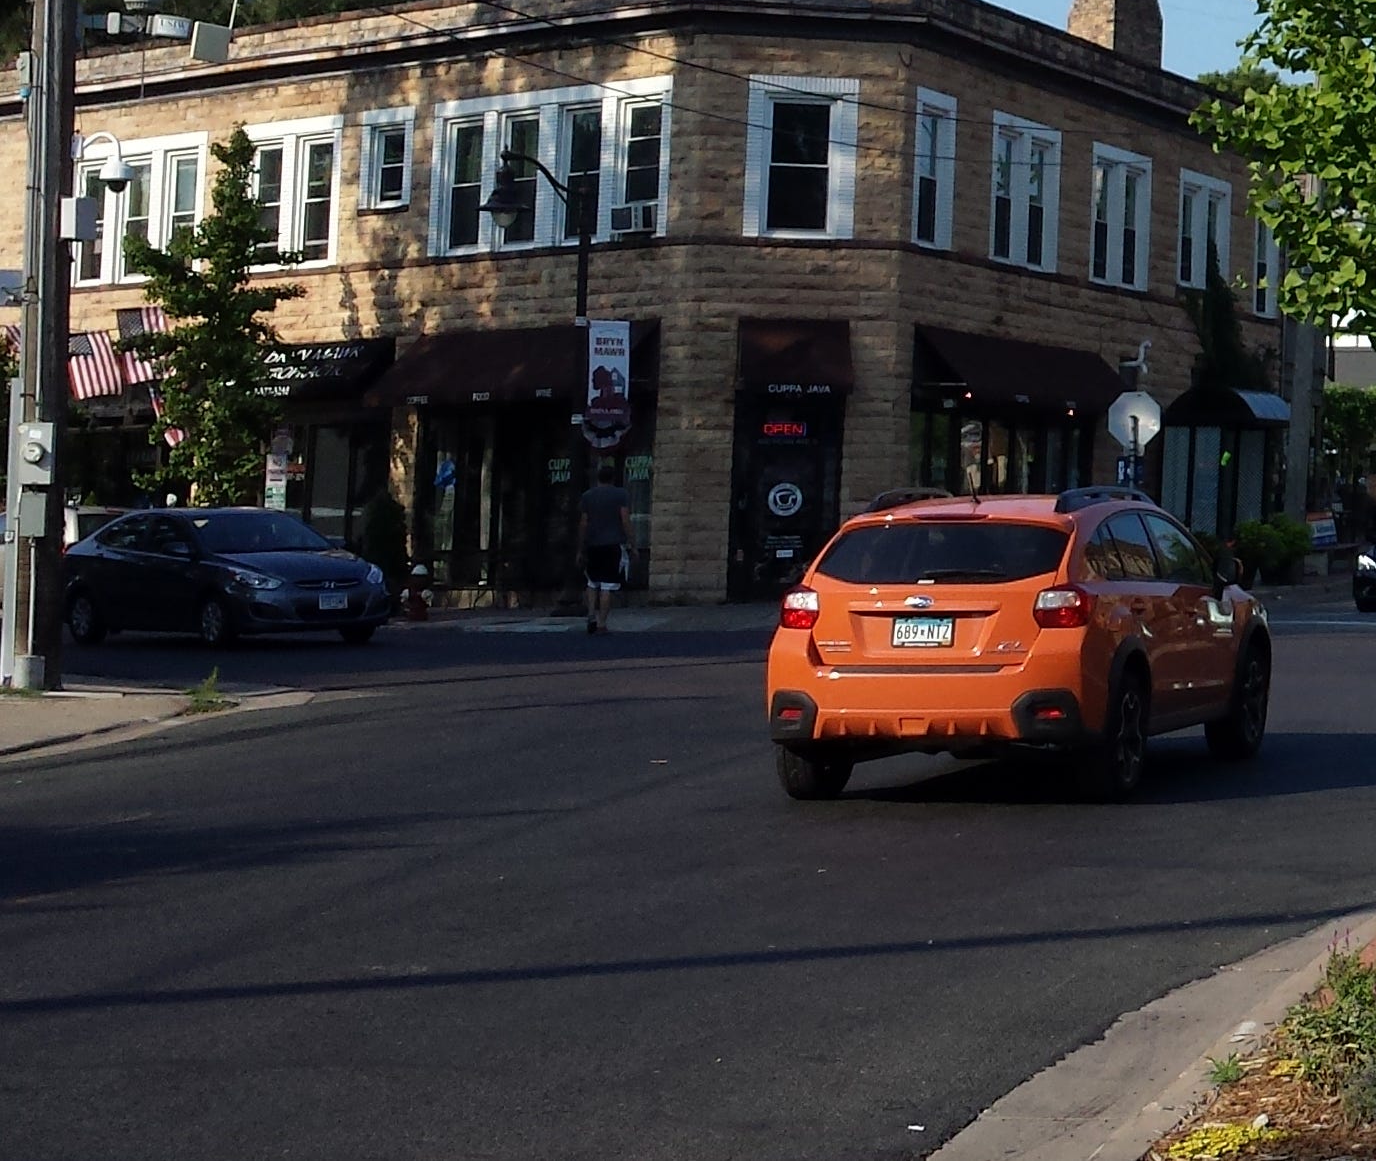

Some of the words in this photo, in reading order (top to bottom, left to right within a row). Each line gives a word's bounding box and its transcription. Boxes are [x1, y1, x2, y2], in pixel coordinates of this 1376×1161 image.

[768, 384, 802, 393] CUPPA
[806, 384, 831, 393] JAVA
[763, 423, 803, 435] OPEN
[897, 625, 919, 639] 689
[927, 624, 950, 639] NTZ
